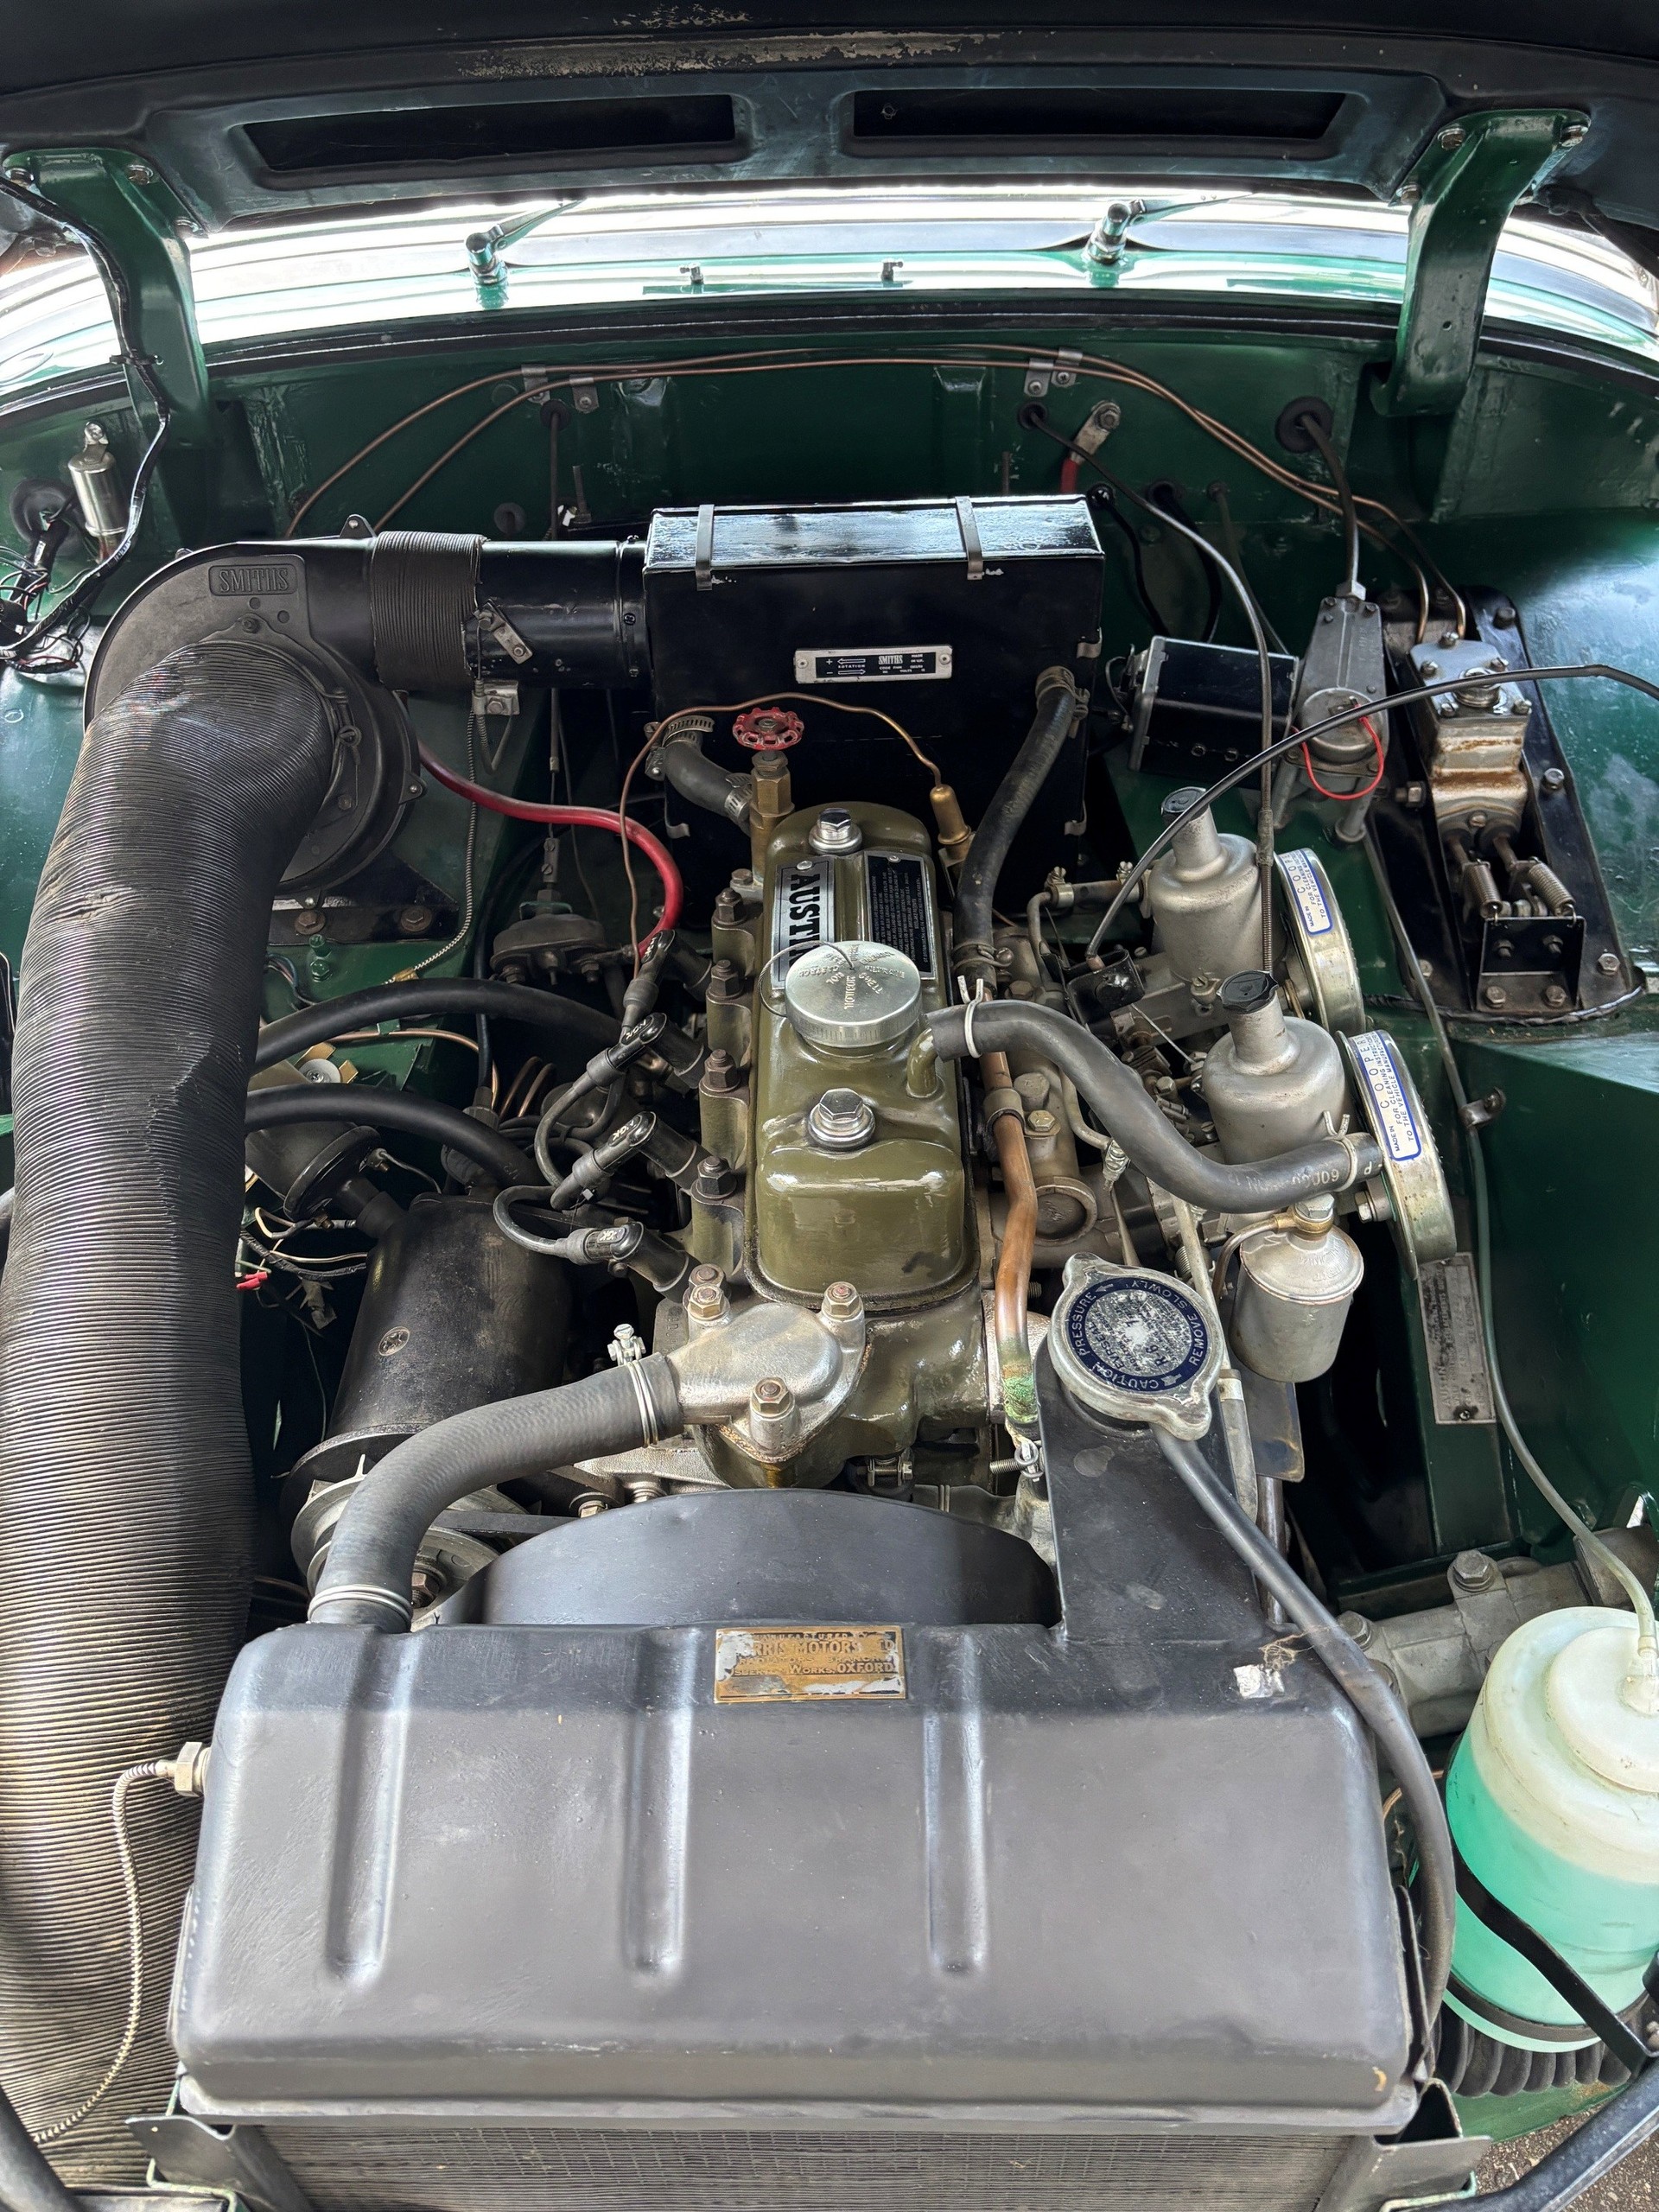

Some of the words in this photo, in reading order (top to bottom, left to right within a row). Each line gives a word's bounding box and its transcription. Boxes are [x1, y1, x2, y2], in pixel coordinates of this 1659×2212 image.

[219, 568, 289, 594] SMITHS
[878, 654, 904, 665] SMITHS
[1313, 893, 1322, 906] THE
[1319, 908, 1325, 918] TO
[843, 975, 856, 1009] MOBILOIL
[857, 969, 884, 995] SHELL
[1379, 1068, 1396, 1105] CLEANING
[1389, 1074, 1403, 1107] VEHICLE
[1392, 1107, 1402, 1125] FOR
[1400, 1110, 1409, 1126] THE
[1390, 1132, 1401, 1152] MADE
[1406, 1129, 1414, 1141] TO
[1071, 1292, 1097, 1357] PRESSURE
[1187, 1313, 1205, 1366] REMOVE
[1437, 1364, 1451, 1406] AUSIN
[795, 1640, 862, 1656] MOTORS
[836, 1662, 895, 1674] OXFORD
